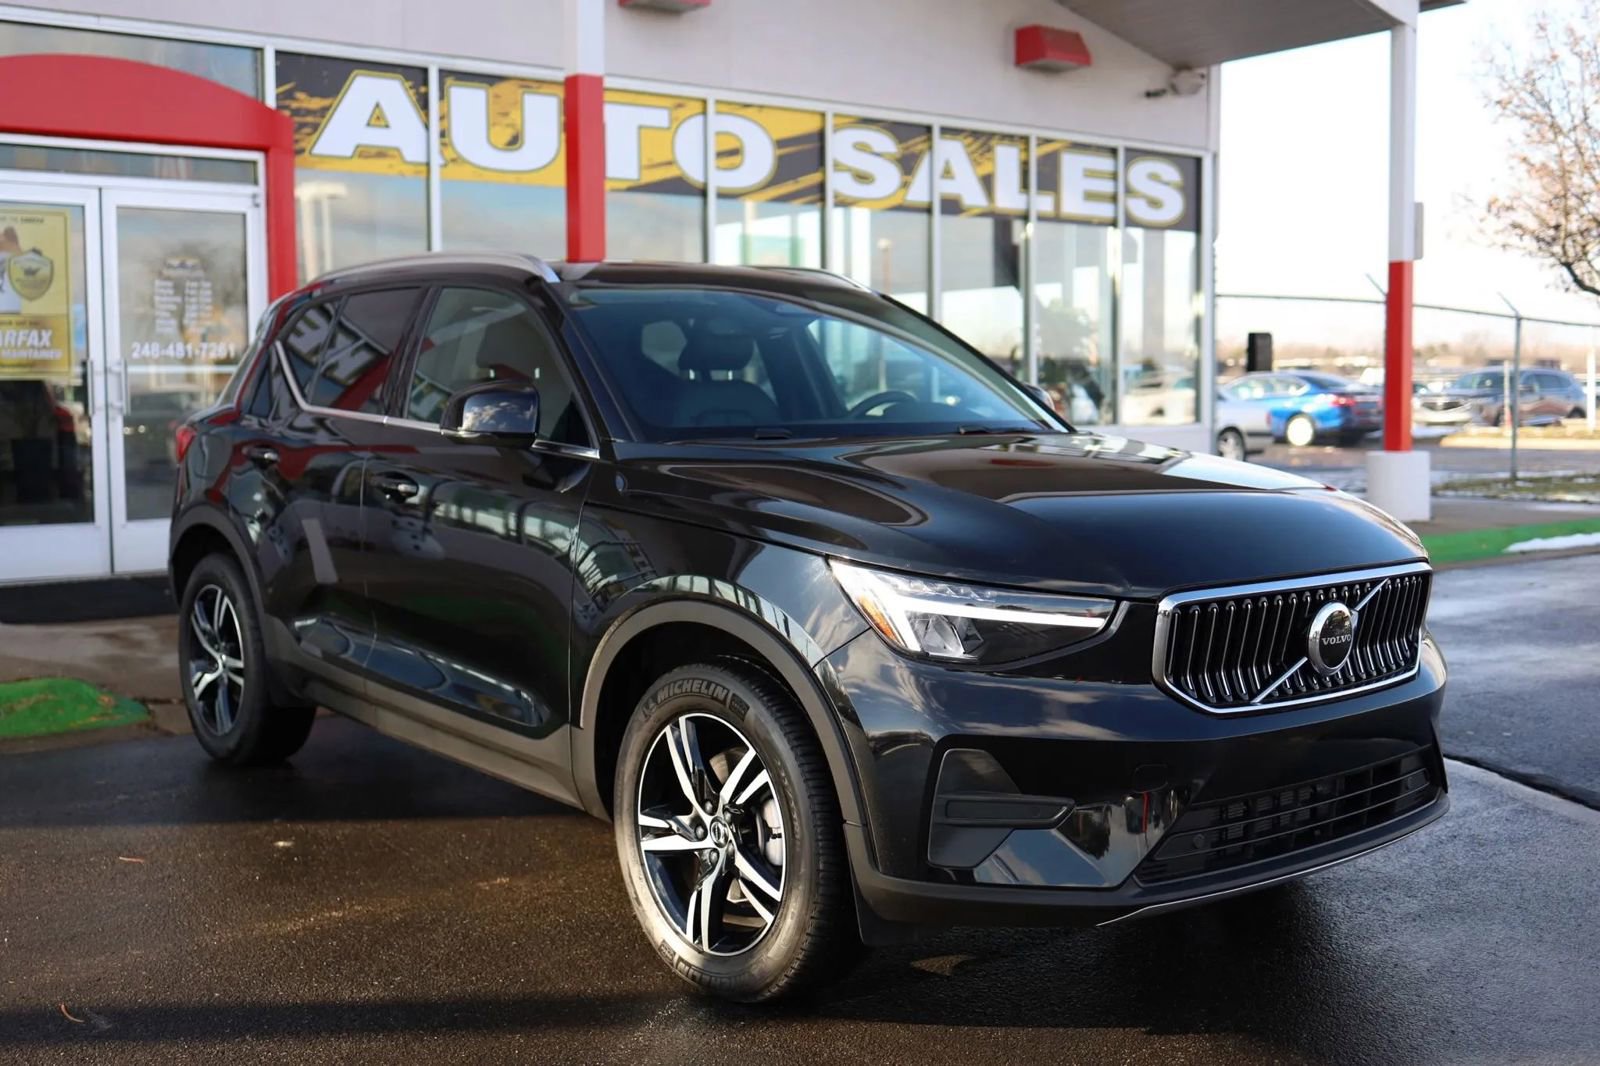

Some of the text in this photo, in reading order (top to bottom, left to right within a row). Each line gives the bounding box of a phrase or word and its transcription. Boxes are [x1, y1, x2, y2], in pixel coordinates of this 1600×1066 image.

[309, 70, 1185, 228] AUTO SALES
[1321, 634, 1352, 645] VOLVO
[657, 679, 728, 704] MICHELIN
